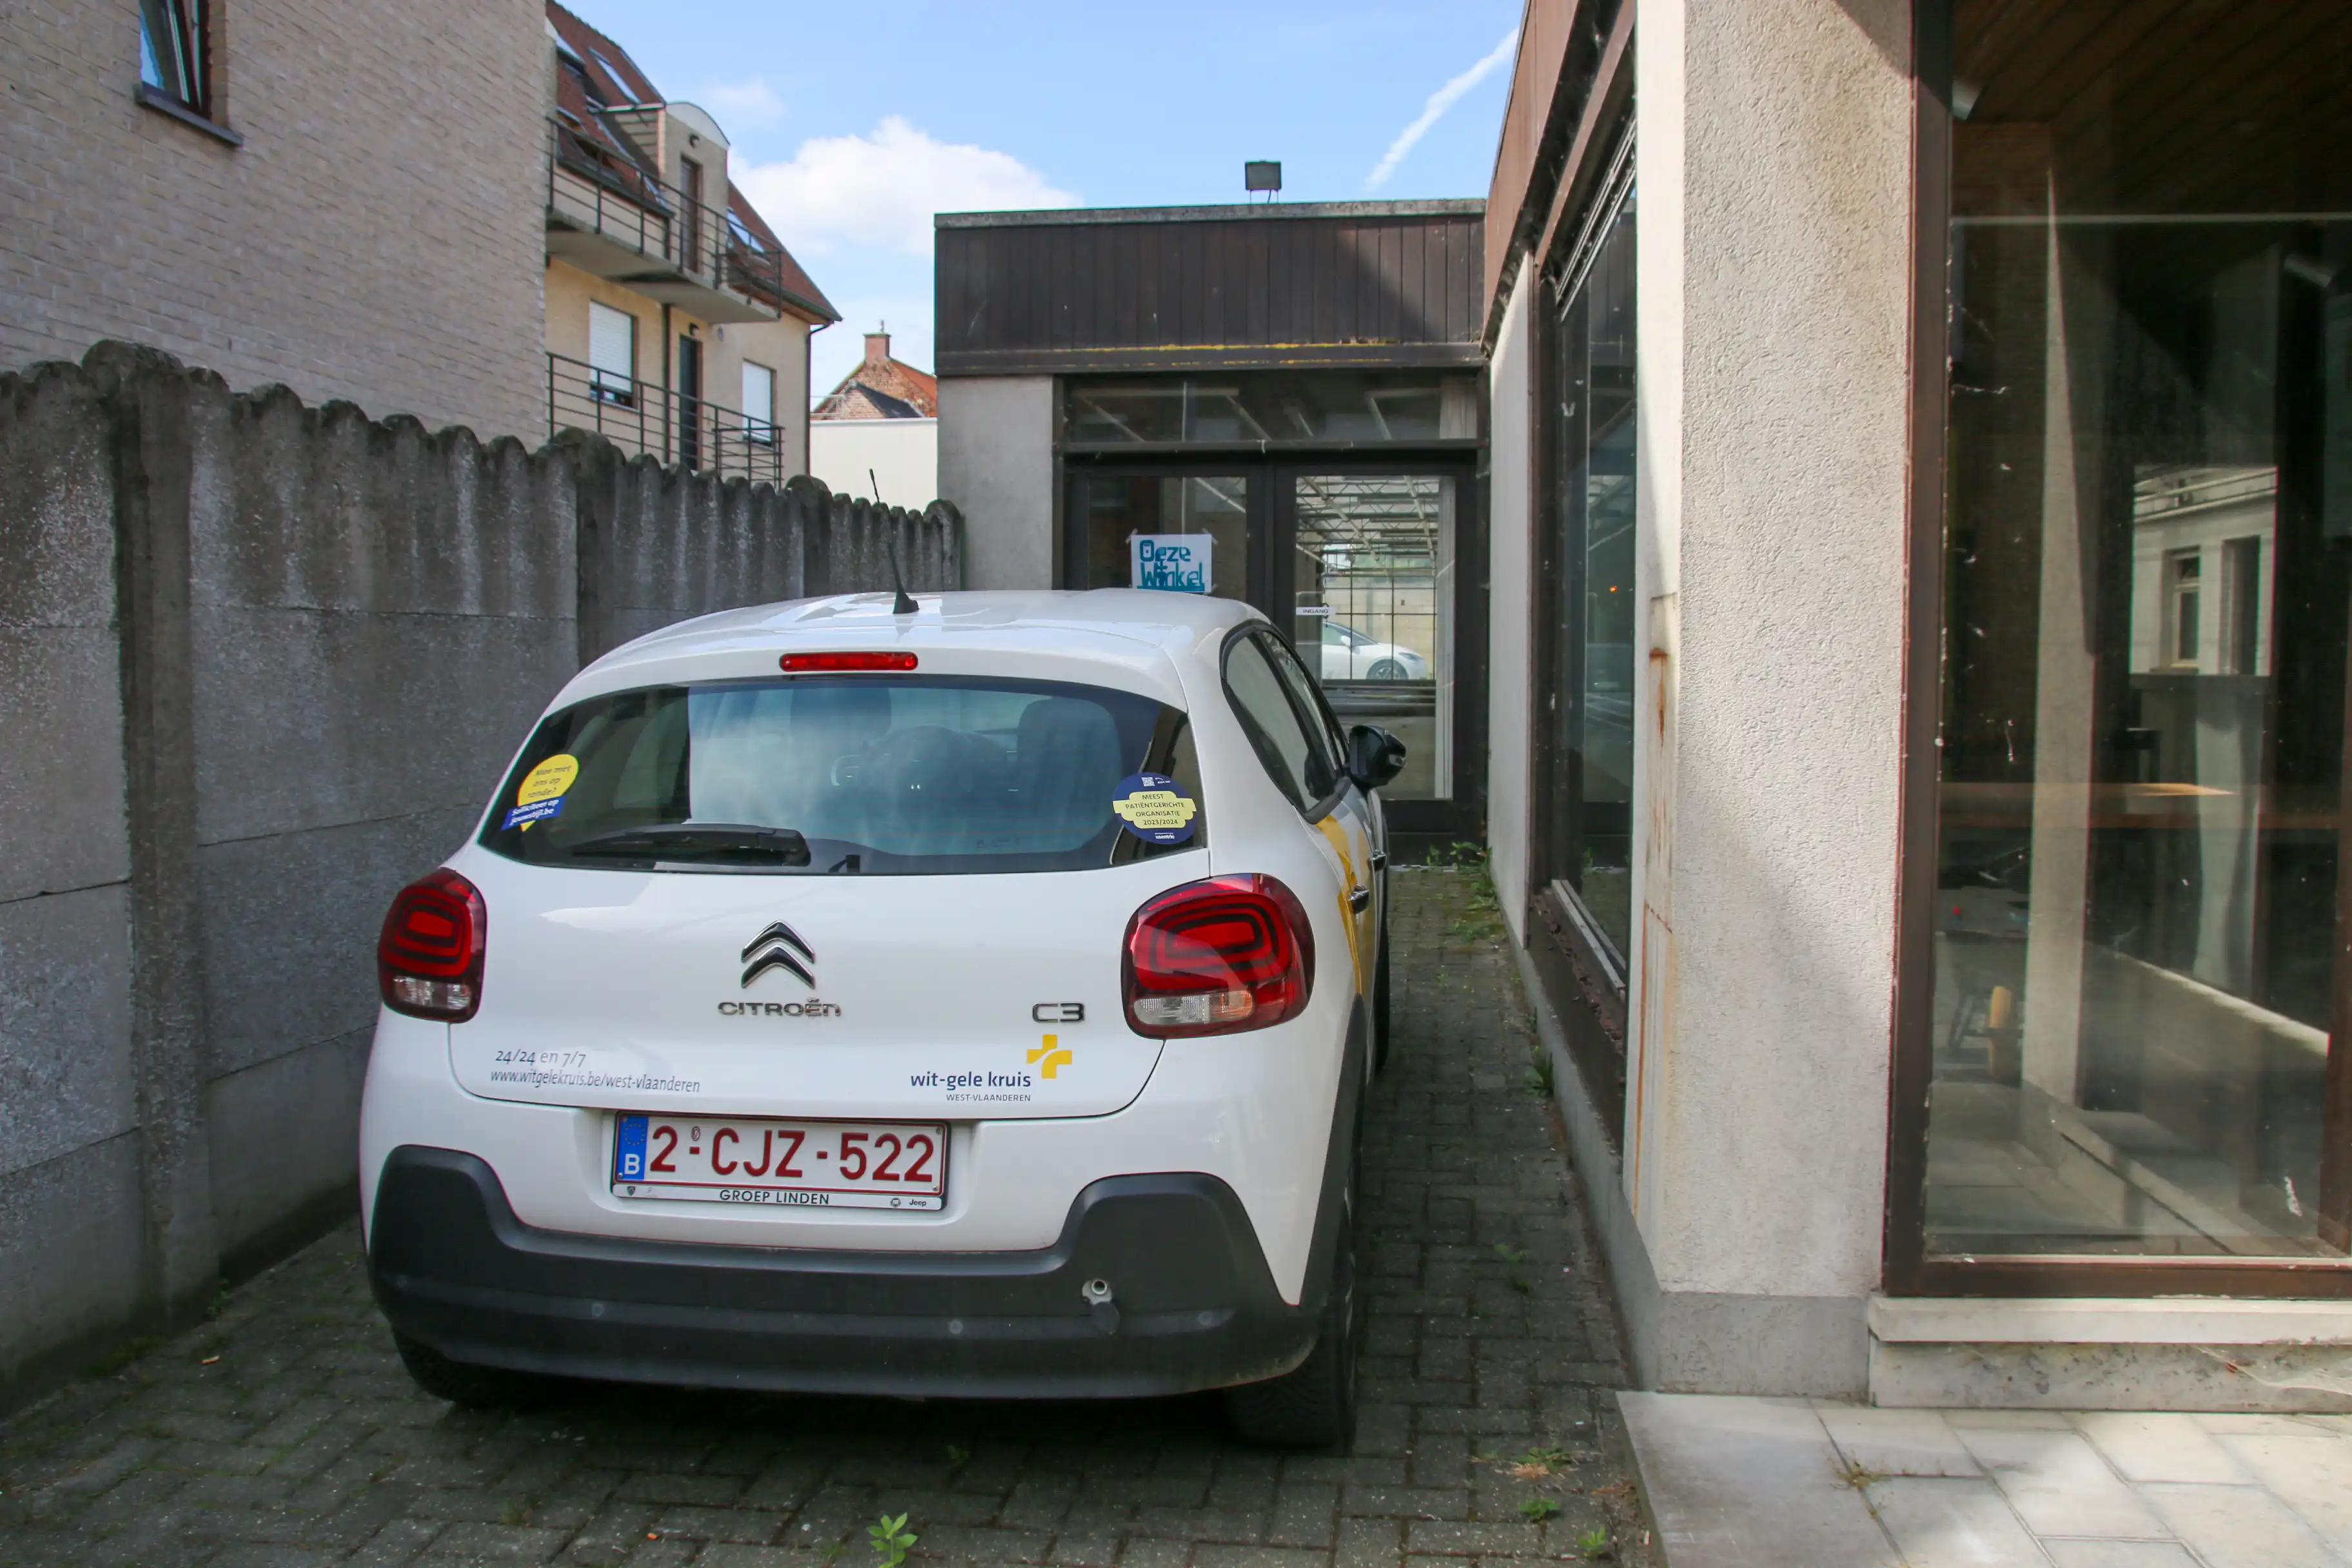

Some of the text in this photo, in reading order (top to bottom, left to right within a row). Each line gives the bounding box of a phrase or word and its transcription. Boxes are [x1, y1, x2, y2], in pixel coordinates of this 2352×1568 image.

[1032, 1002, 1084, 1023] C3
[495, 1049, 586, 1067] 24/24 en 7/7
[490, 1069, 700, 1093] www.witgelekruis.be/west-vlaanderen
[910, 1071, 1032, 1091] wit-gele kruis
[946, 1094, 1032, 1102] WEST-VLAANDEREN
[649, 1124, 934, 1182] 2-CJZ-522
[624, 1153, 640, 1175] B
[720, 1189, 829, 1205] GROEP LINDEN
[908, 1199, 926, 1207] Jeep
